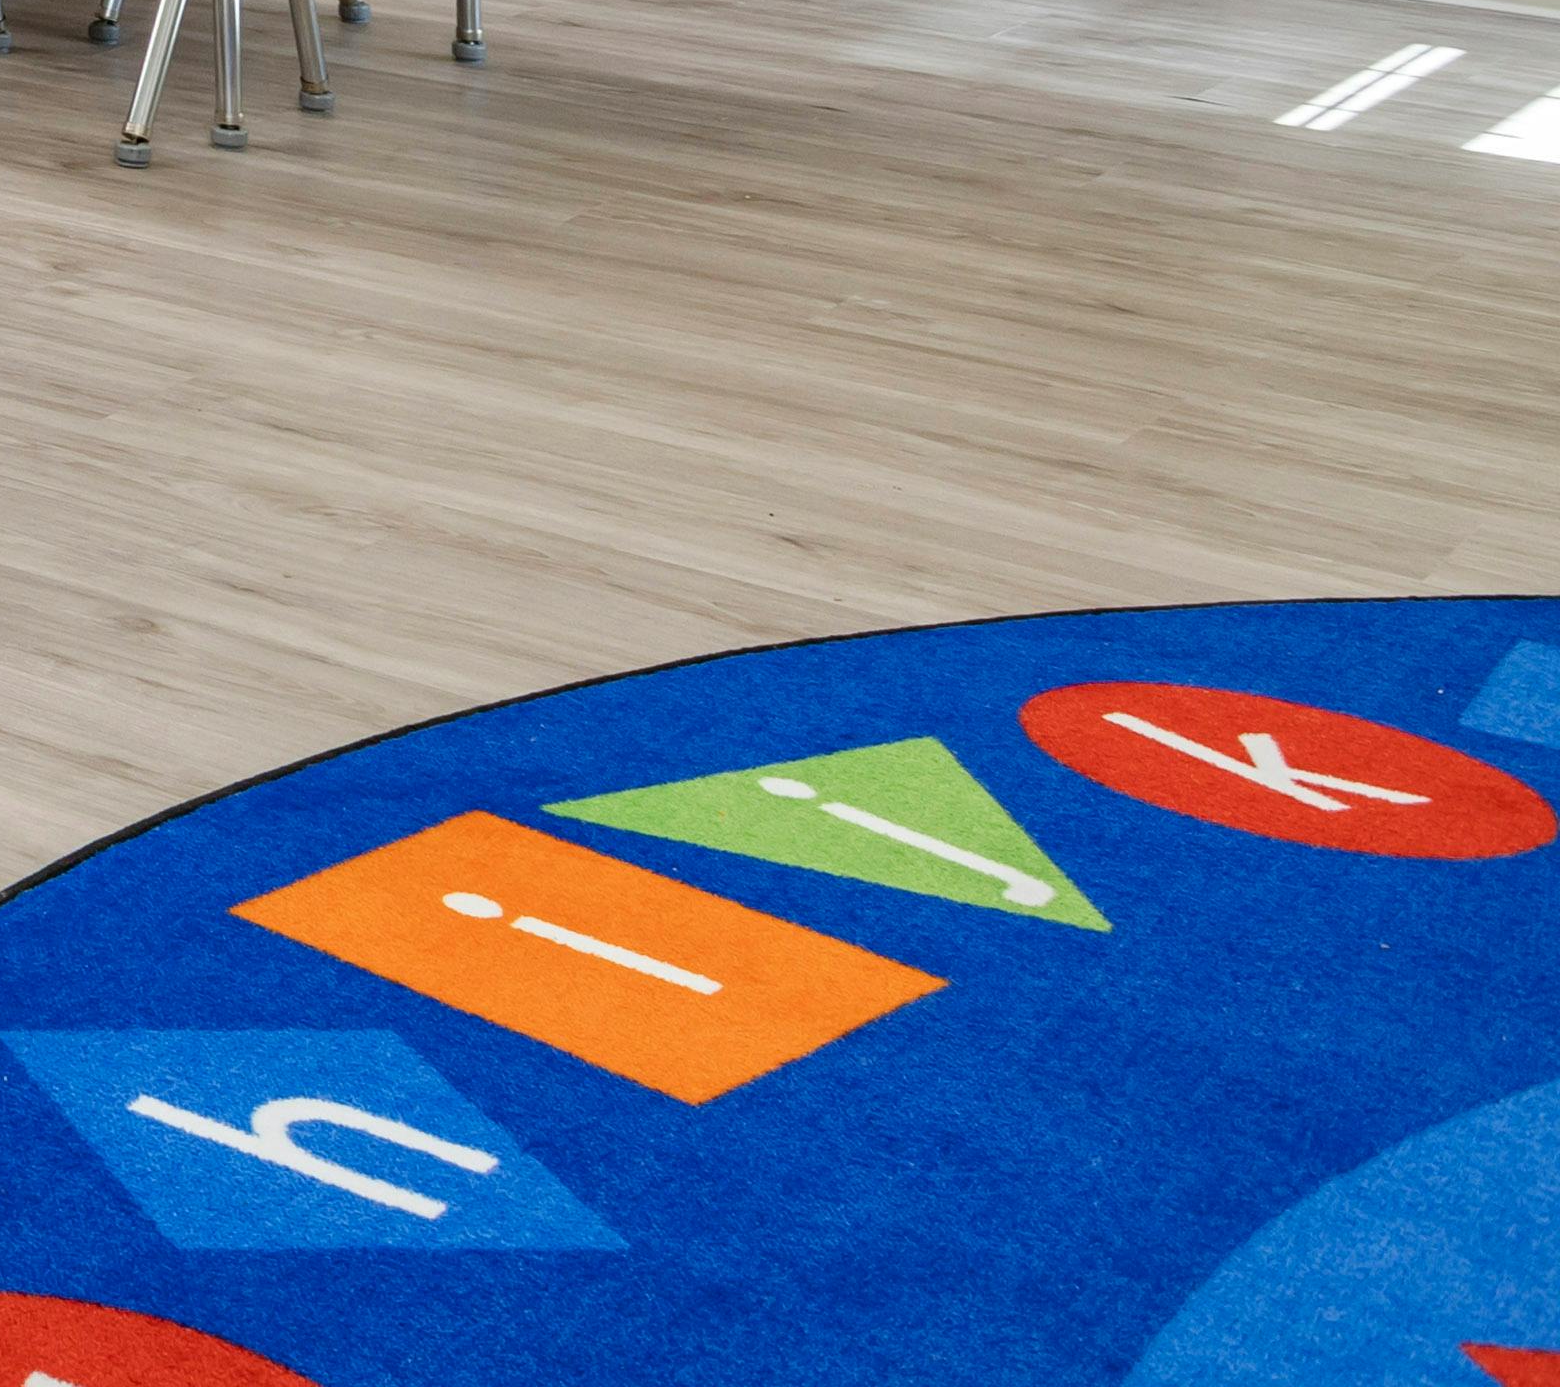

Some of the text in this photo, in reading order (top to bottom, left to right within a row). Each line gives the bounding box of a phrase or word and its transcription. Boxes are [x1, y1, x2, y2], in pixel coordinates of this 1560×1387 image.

[1100, 711, 1433, 812] k
[757, 776, 1057, 907] j
[441, 890, 723, 996] i
[127, 1094, 499, 1220] h
